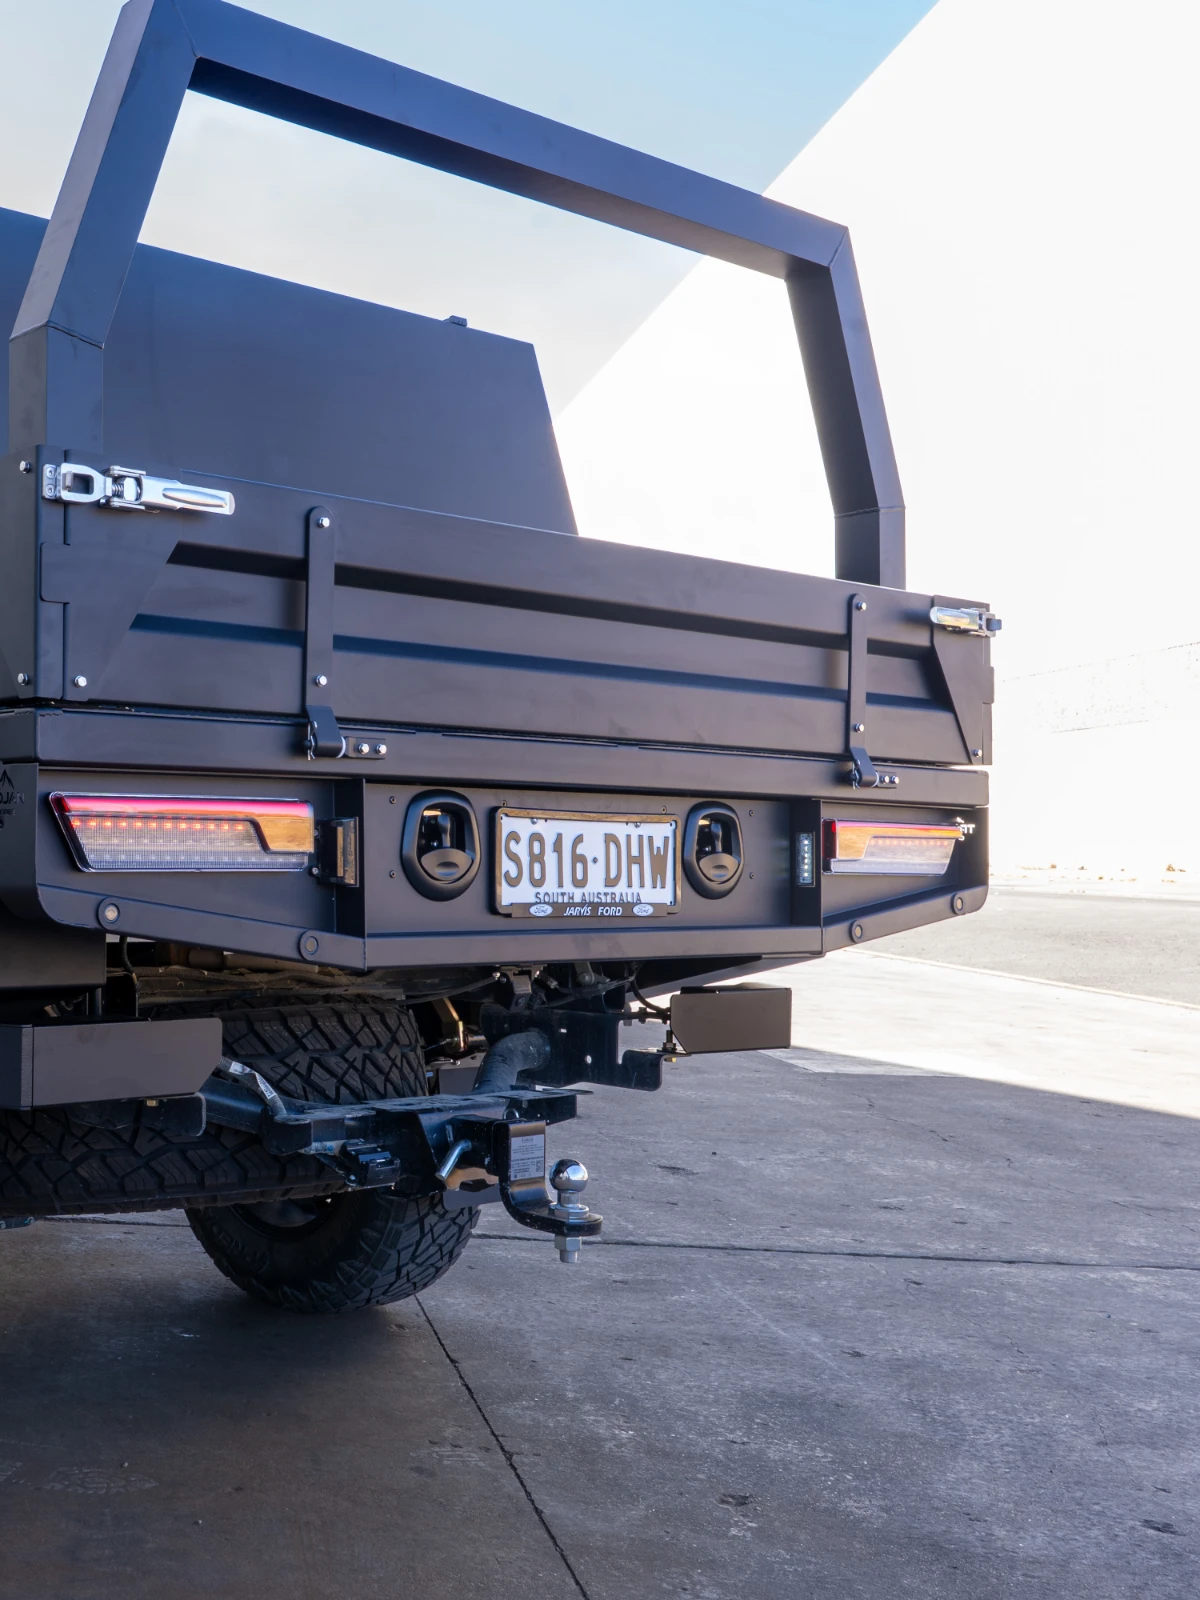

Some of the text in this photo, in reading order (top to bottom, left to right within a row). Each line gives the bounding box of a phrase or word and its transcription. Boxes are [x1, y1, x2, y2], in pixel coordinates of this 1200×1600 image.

[535, 892, 642, 904] SOUTH AUSTRALIA
[564, 904, 623, 916] JARVIS FORD
